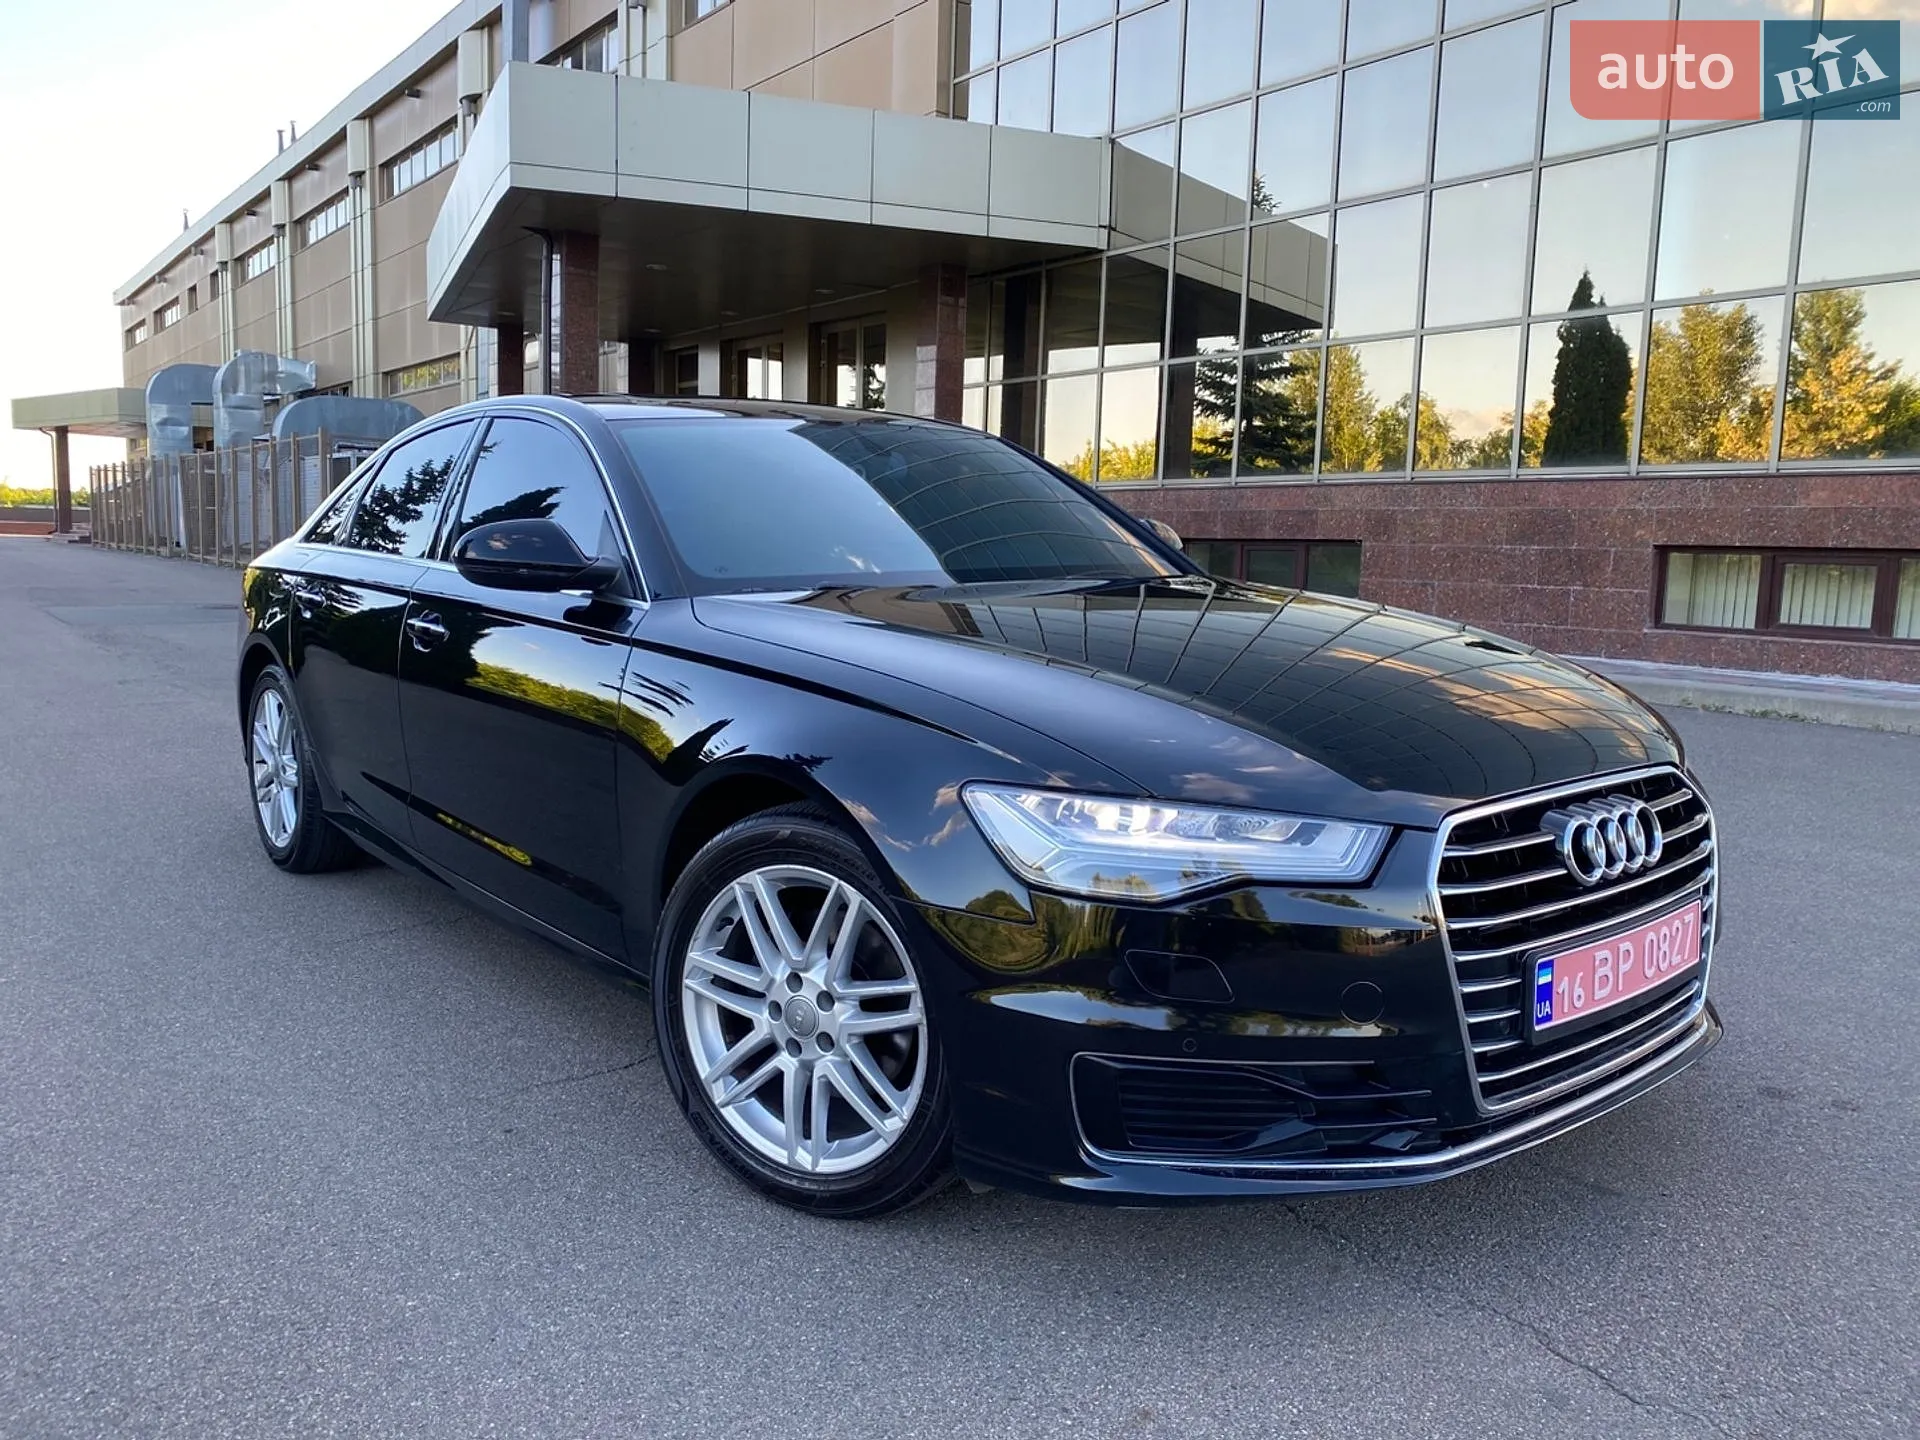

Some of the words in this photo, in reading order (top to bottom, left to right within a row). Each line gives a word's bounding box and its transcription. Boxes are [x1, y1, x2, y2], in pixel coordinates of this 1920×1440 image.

[1556, 971, 1585, 1013] 16
[1593, 941, 1634, 1001] BP
[1643, 911, 1695, 980] 0827
[1537, 1001, 1552, 1018] UA
